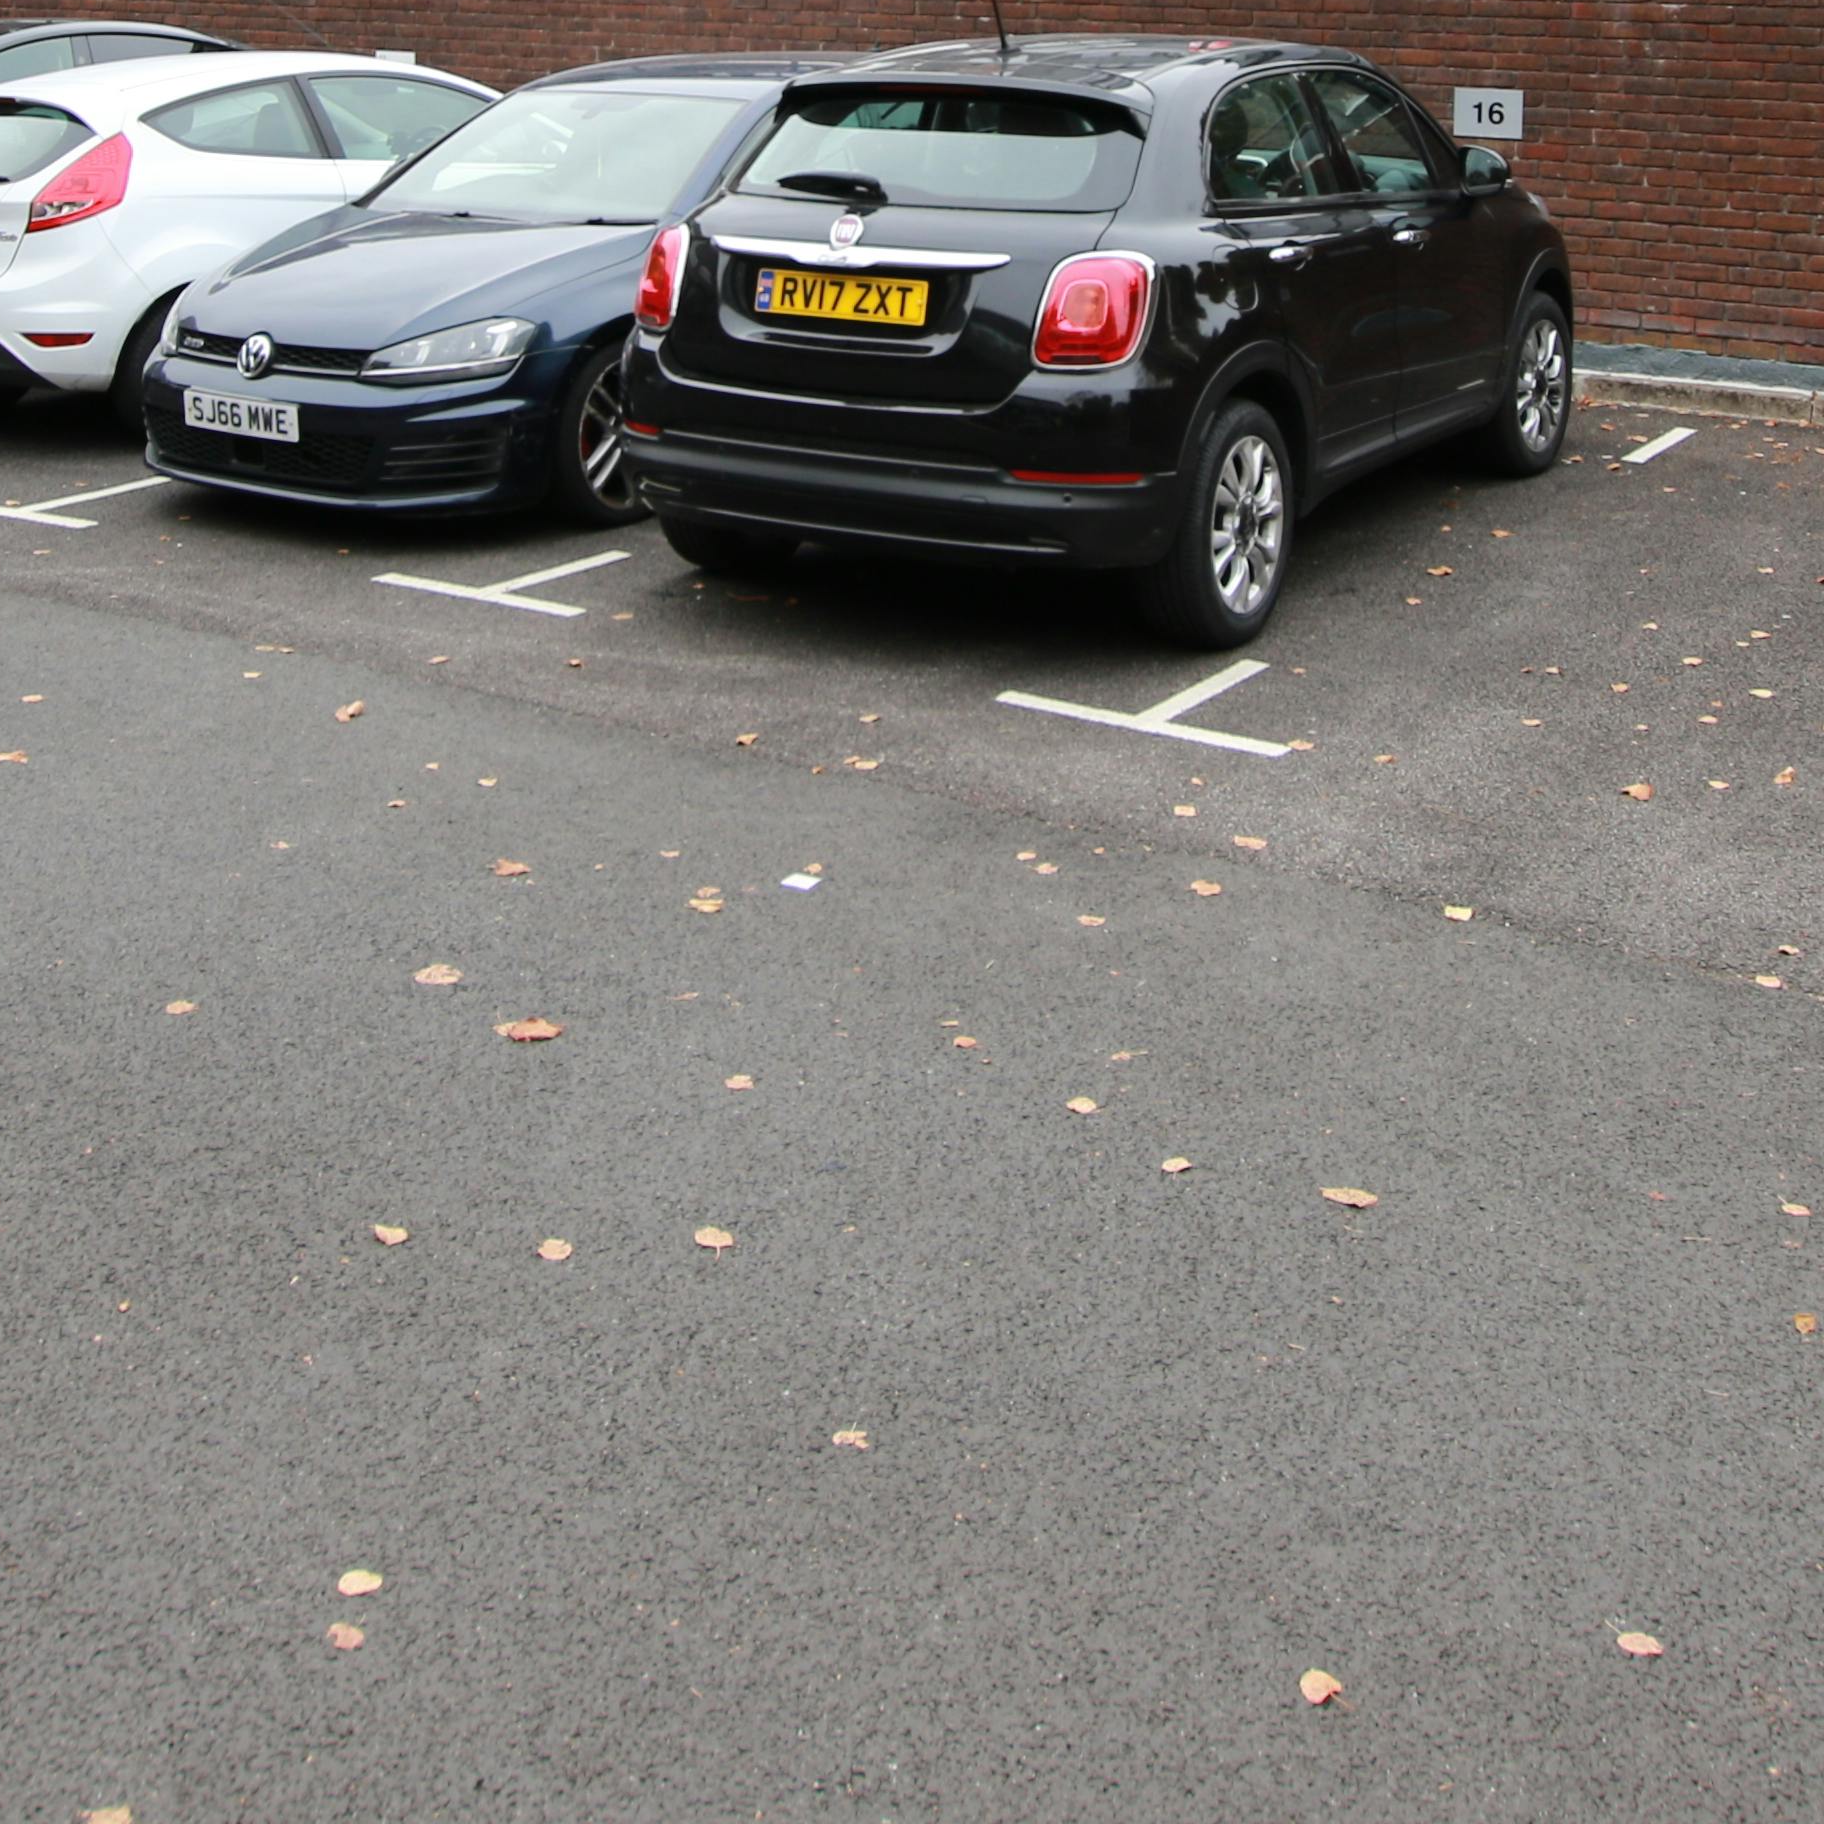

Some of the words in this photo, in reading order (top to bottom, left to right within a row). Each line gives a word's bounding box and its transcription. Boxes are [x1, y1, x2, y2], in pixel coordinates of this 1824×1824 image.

[1472, 101, 1505, 125] 16
[780, 277, 845, 311] RV17
[853, 282, 914, 317] ZXT
[192, 397, 242, 428] SJ66
[248, 404, 288, 435] MWE
